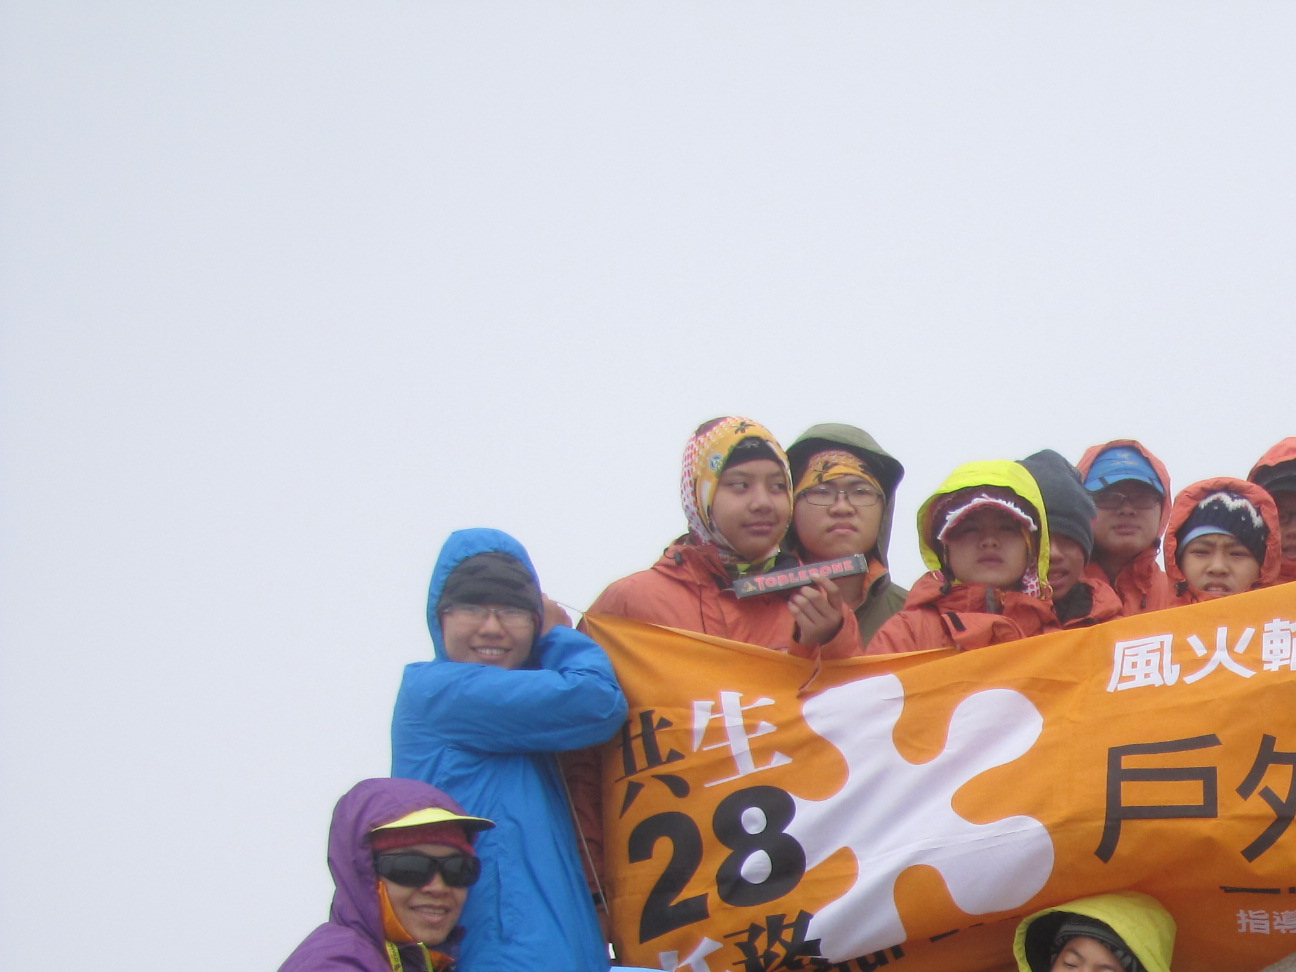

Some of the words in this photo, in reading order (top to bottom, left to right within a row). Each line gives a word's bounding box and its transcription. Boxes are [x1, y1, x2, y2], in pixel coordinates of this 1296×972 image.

[753, 559, 855, 591] TOBLERONE
[615, 690, 793, 821] 共生
[628, 784, 807, 944] 28
